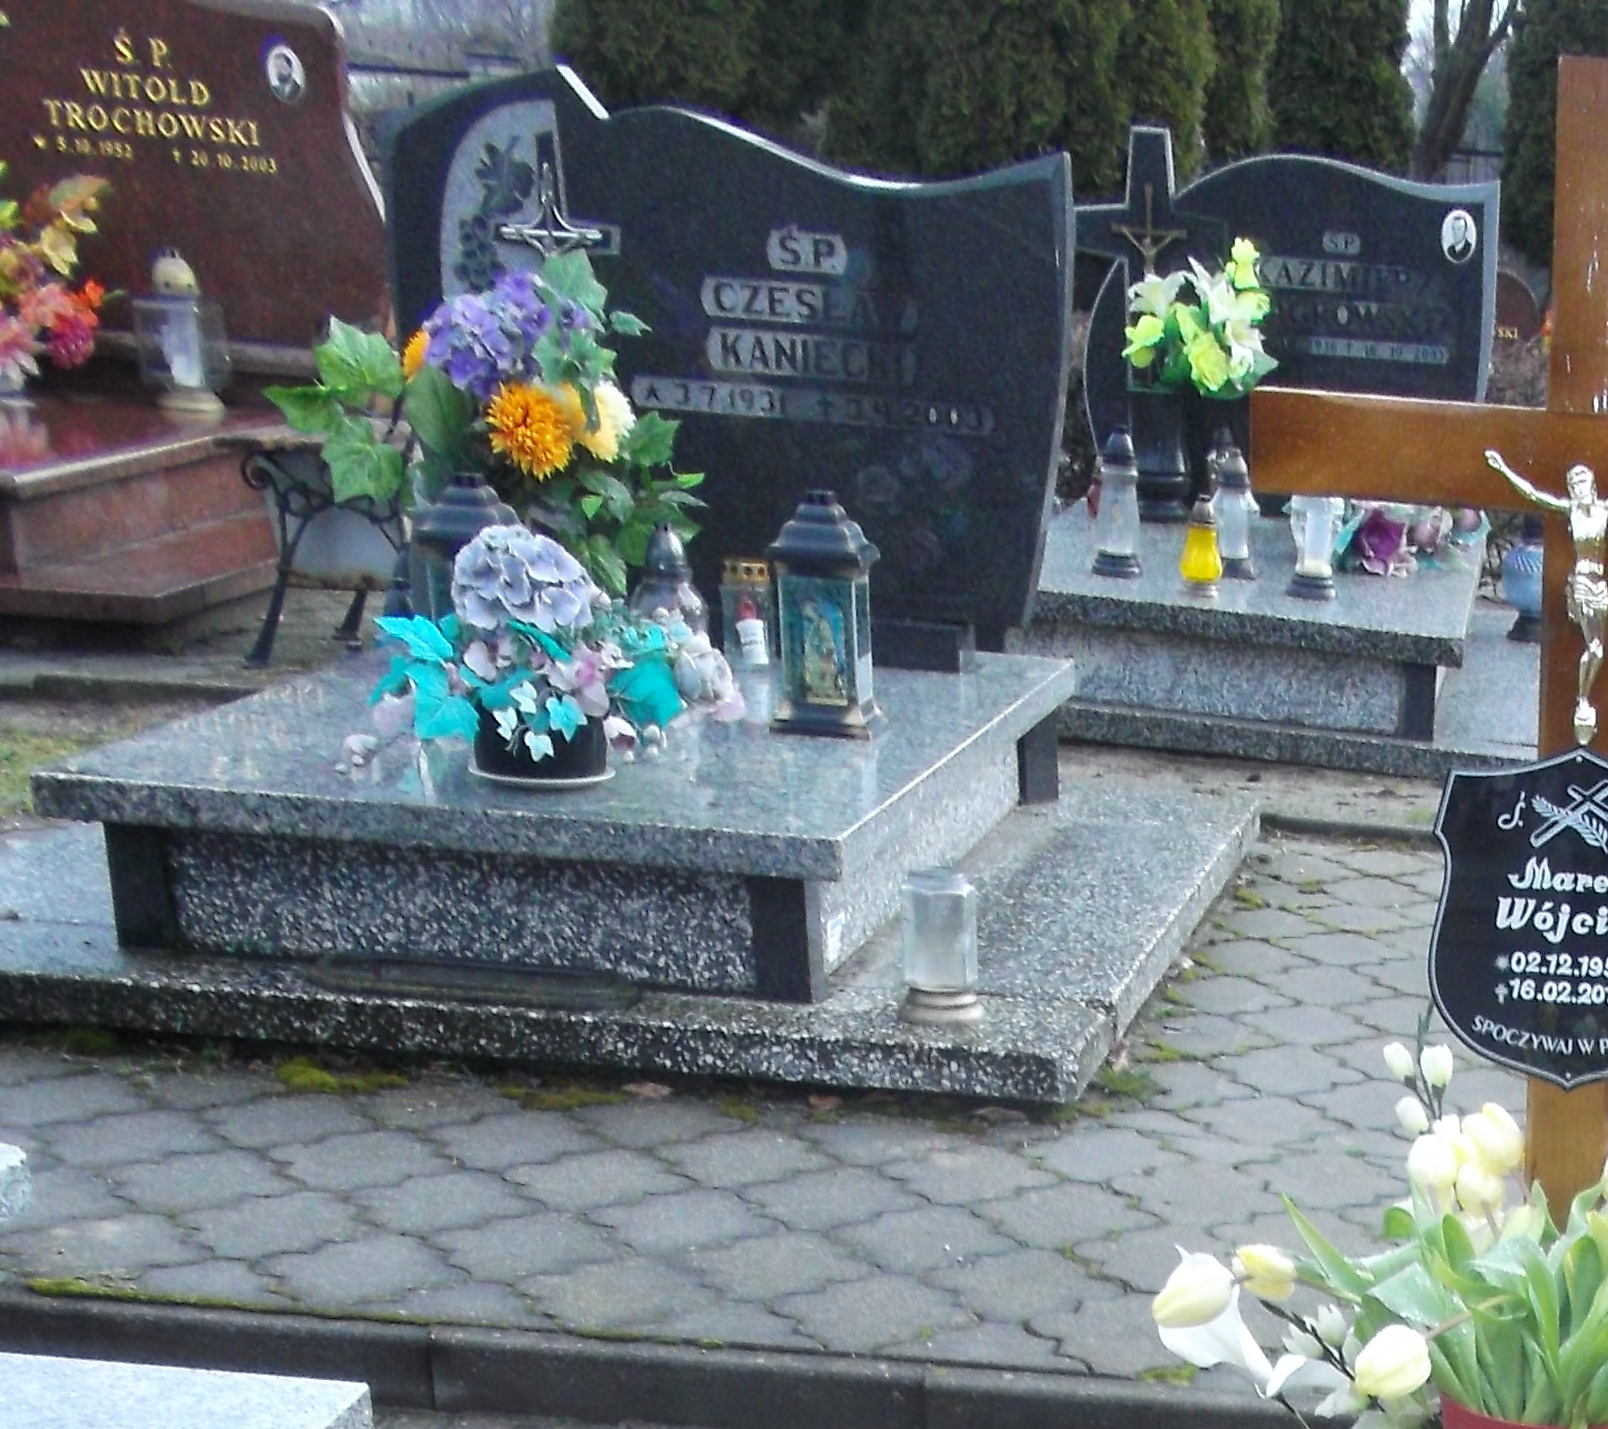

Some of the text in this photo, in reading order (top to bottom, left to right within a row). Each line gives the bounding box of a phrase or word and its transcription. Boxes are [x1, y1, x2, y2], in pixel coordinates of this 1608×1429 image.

[79, 66, 211, 107] WITOLD
[42, 97, 261, 148] TROCHOWSKI
[1471, 1014, 1574, 1056] SPOCZYWAJ
[1576, 1037, 1596, 1056] W
